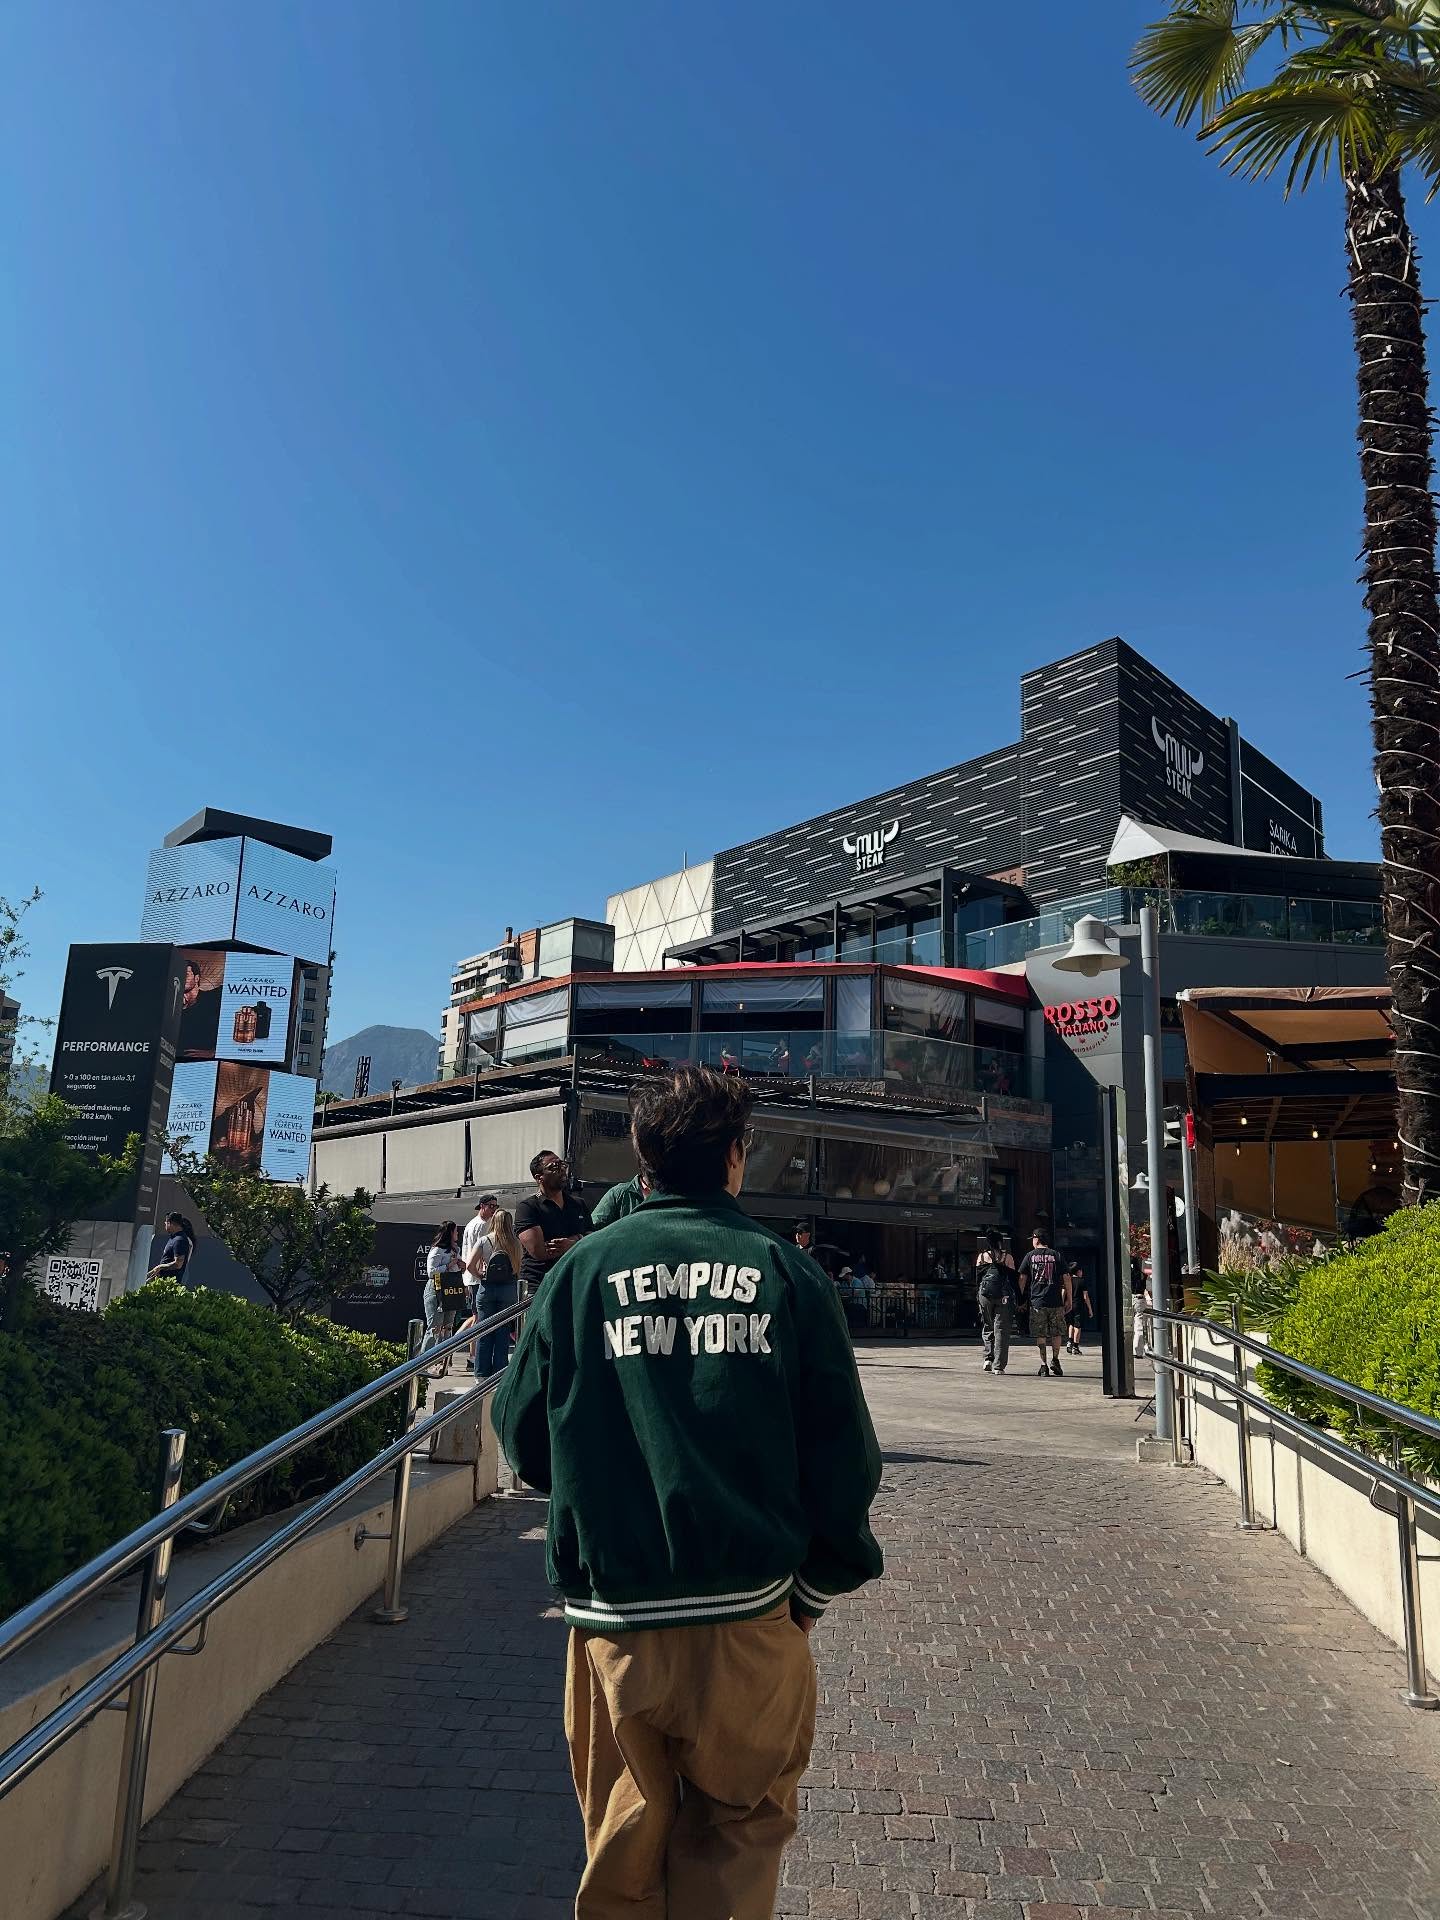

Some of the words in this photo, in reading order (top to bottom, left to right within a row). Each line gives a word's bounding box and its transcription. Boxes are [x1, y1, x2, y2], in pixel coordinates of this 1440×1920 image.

[1166, 766, 1192, 800] STEAK
[856, 851, 884, 871] STEAK
[152, 881, 230, 904] AZZARO
[247, 885, 326, 920] AZZARO
[227, 983, 288, 998] WANTED
[1043, 996, 1118, 1024] ROSSO
[1056, 1020, 1108, 1037] ITALIANO
[62, 1041, 150, 1053] PERFORMANCE
[79, 1073, 92, 1081] 100
[66, 1083, 97, 1091] segundos
[172, 1110, 203, 1120] FOREVER
[276, 1112, 303, 1121] AZZARO
[168, 1120, 206, 1132] WANTED
[274, 1119, 303, 1130] FOREVER
[269, 1128, 307, 1143] WANTED
[607, 1262, 762, 1307] TEMPUS
[603, 1315, 677, 1360] NEW
[684, 1313, 772, 1356] YORK
